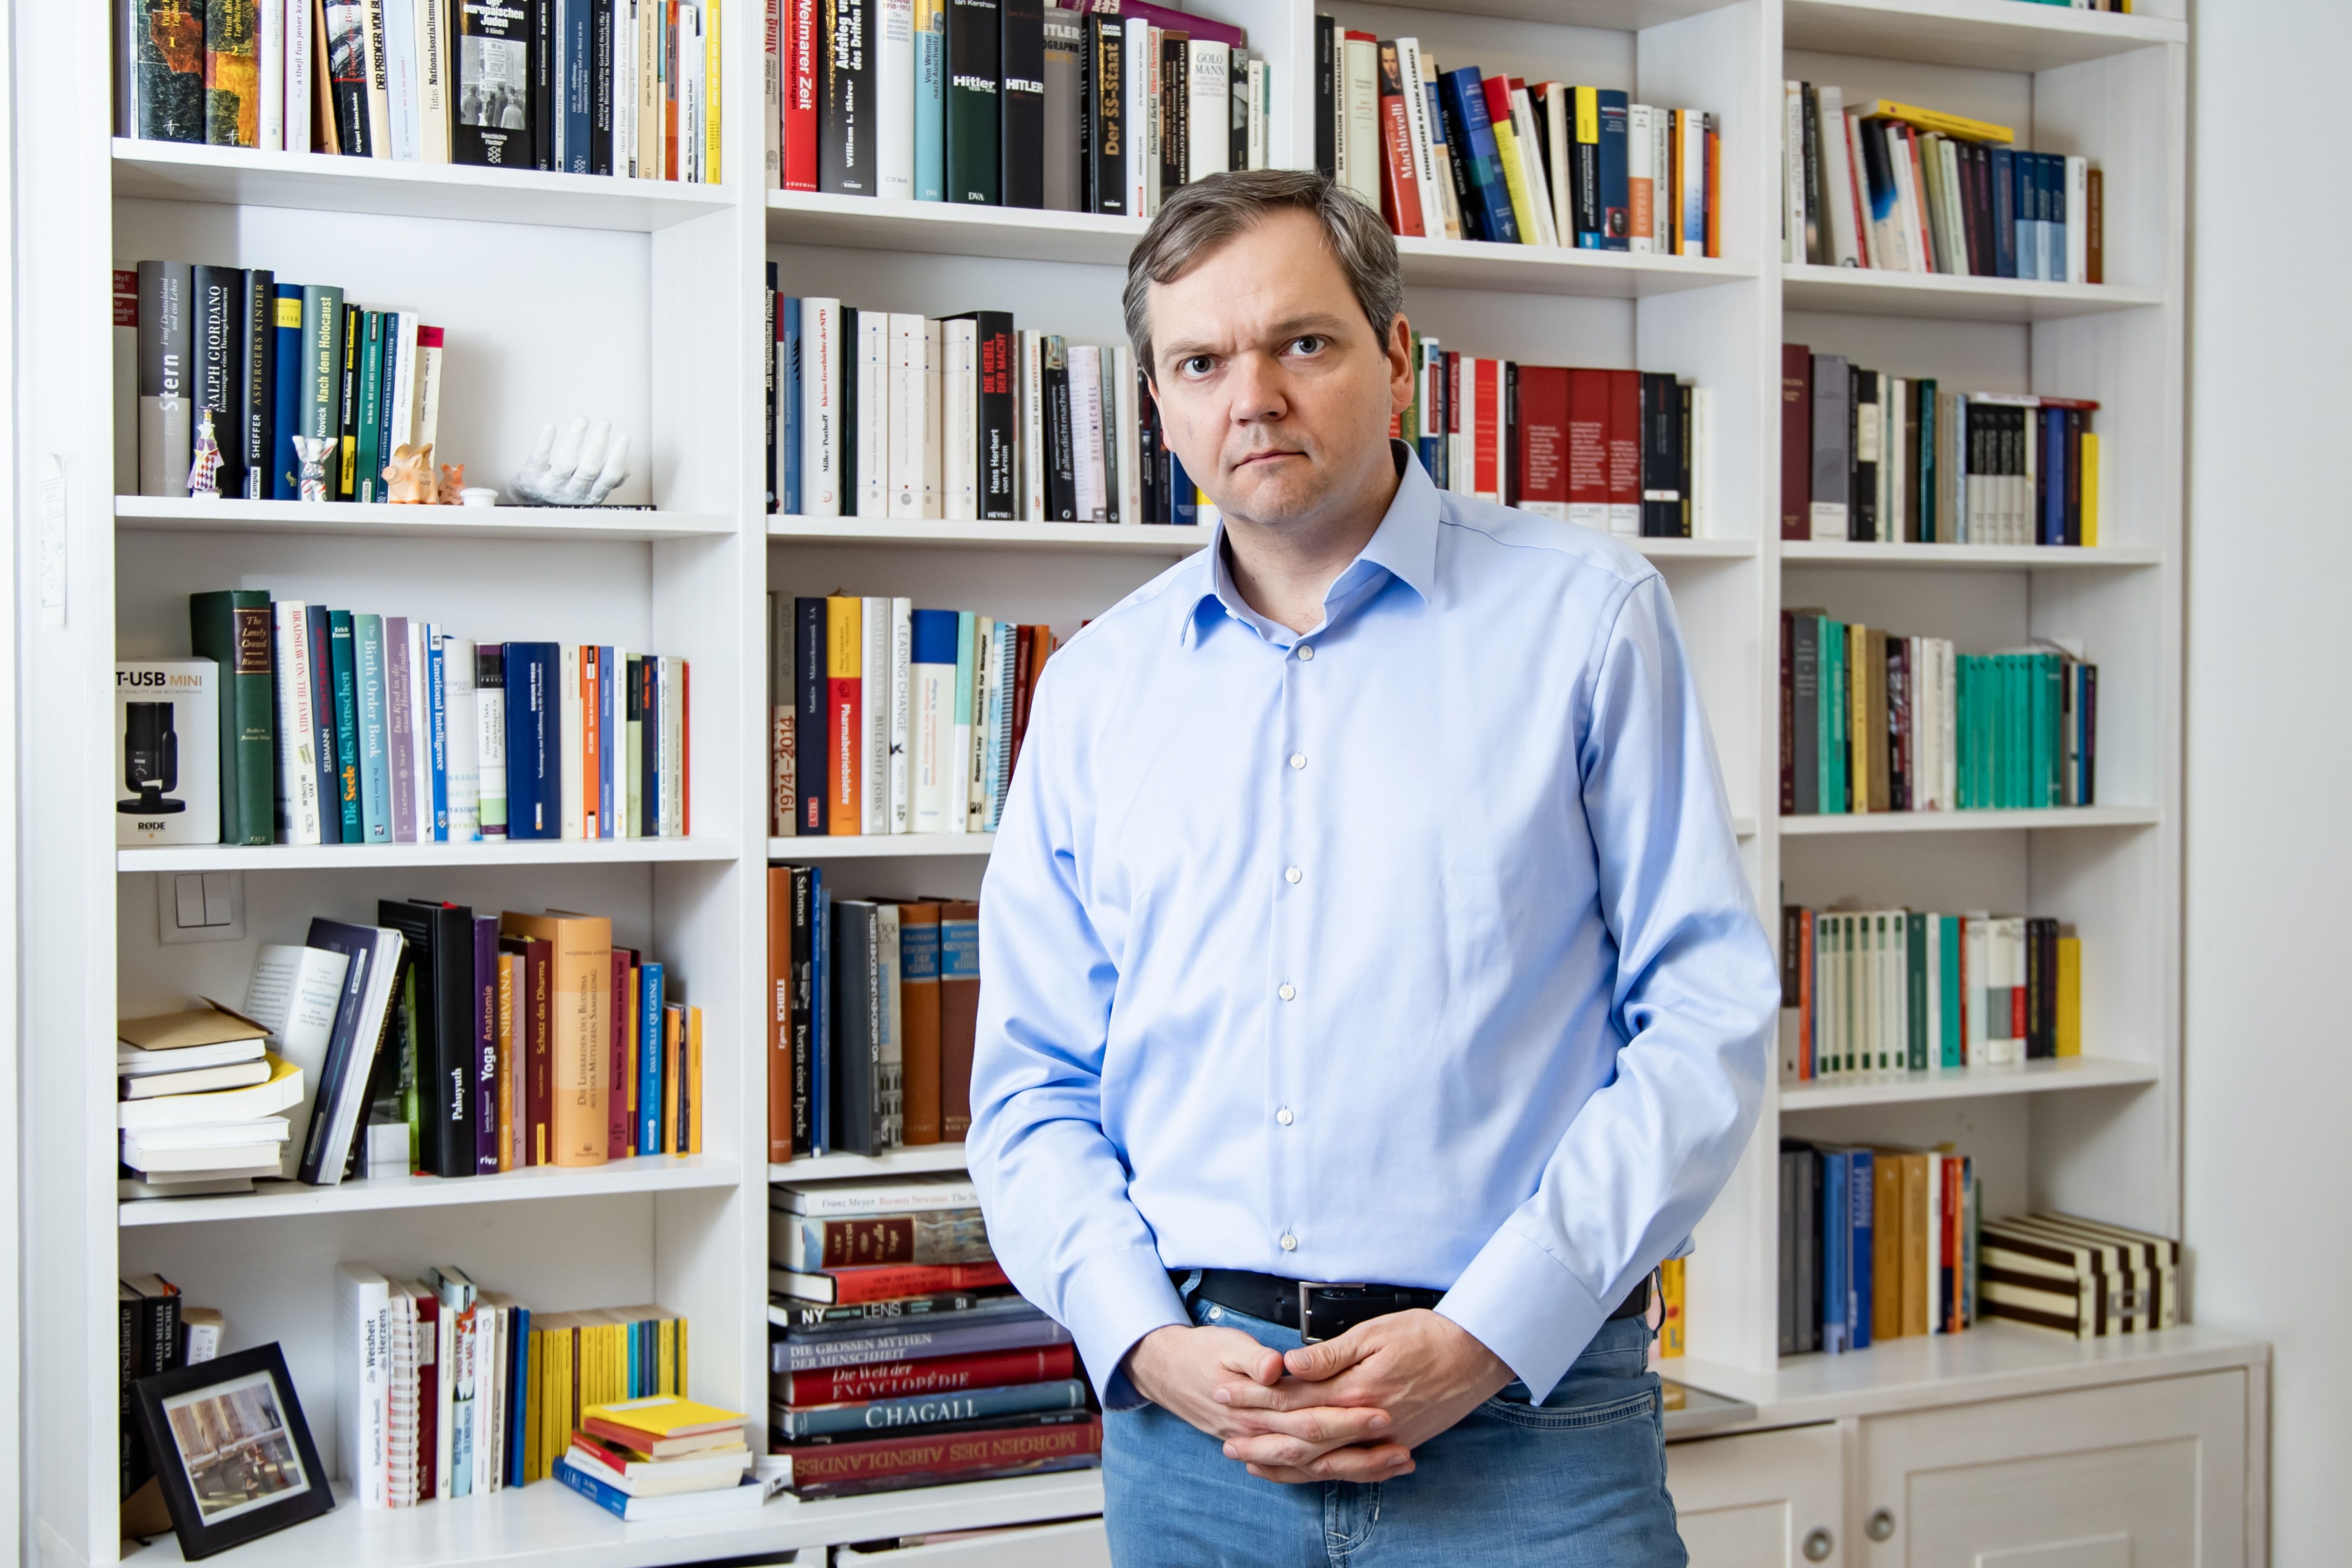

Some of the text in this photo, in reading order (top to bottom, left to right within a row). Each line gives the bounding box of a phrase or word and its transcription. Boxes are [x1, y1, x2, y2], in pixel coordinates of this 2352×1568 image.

[463, 4, 524, 19] europäischen
[480, 15, 508, 28] Juden
[1043, 23, 1080, 40] ITLER
[169, 37, 176, 47] 1
[231, 46, 239, 56] 2
[371, 12, 386, 90] DER PREDIGER VON
[764, 18, 778, 55] Alltag
[799, 0, 812, 110] Weimarer Zeit
[835, 16, 851, 69] Aufstieg
[850, 8, 862, 70] des Dritten
[1196, 52, 1223, 64] GOLO
[953, 76, 996, 89] Hitler
[1006, 78, 1043, 94] HITLER
[1195, 65, 1224, 76] MANN
[430, 89, 439, 112] Tutas
[1105, 43, 1119, 155] Der SS-Staat
[1409, 48, 1432, 180] ETHNISCHER RADIKALISMUS
[845, 80, 854, 168] William L. Shirer
[1391, 104, 1413, 179] Machiavelli
[968, 192, 984, 202] DVA
[160, 278, 171, 345] Fünf Deutschland
[220, 287, 229, 349] Davongekommenen
[208, 286, 220, 411] RALPH GIORDANO
[317, 297, 332, 437] Novick Nach dem Holocaust
[983, 340, 995, 393] DIE HEBEL
[996, 332, 1006, 393] DER MACHT
[158, 354, 179, 412] Stern
[220, 369, 228, 412] Erinnerungen
[251, 284, 264, 459] SHEFFER ASPERGERS KINDER
[990, 429, 999, 493] Hans Herbert
[242, 628, 266, 639] Lonely
[247, 616, 262, 625] The
[242, 639, 267, 648] Crowd
[115, 672, 202, 687] T-USB MINI
[292, 610, 309, 734] BRADSHAW ON: THE FAMILY
[896, 625, 908, 733] LEADING CHANGE
[364, 640, 382, 759] Birth Order Book
[433, 657, 445, 771] Emotional Intelligence
[322, 729, 332, 773] SELBMANN
[338, 672, 357, 825] Die Seele des Menschen
[840, 704, 851, 804] Pharmabetriebslehre
[872, 715, 884, 810] BULLSHIT JOBS
[138, 821, 166, 830] RØDE
[797, 876, 806, 926] Salomon
[301, 989, 337, 1001] Konservative
[500, 968, 511, 1037] NIRVANA
[536, 960, 545, 1054] Schatz des Dharma
[578, 975, 587, 1014] BUDDHA
[649, 978, 658, 1011] GONG
[777, 979, 787, 1049] Egon SCHIELE
[481, 985, 497, 1081] Yoga Anatomie
[649, 1012, 660, 1025] QI
[577, 1035, 587, 1085] LEHRREDEN
[794, 1025, 807, 1138] Porträt einer Epoche
[451, 1067, 465, 1120] Pahuyuth
[577, 1089, 587, 1105] DIE
[480, 1155, 498, 1165] riva
[822, 1200, 846, 1208] Franz
[848, 1199, 875, 1207] Meyer
[879, 1197, 909, 1205] Barnett
[952, 1194, 967, 1202] The
[164, 1304, 172, 1340] MICHEL
[801, 1309, 825, 1325] NY
[862, 1302, 902, 1319] LENS
[365, 1318, 375, 1367] Weisheit
[791, 1332, 932, 1358] DIE GROSSEN MYTHEN
[791, 1349, 905, 1369] DER MENSCHHEIT
[833, 1363, 913, 1382] Die Welt der
[833, 1371, 969, 1400] ENCYCLOPÉDIE
[866, 1399, 979, 1428] CHAGALL
[795, 1432, 1076, 1477] MORGEN DES ABENDLANDES
